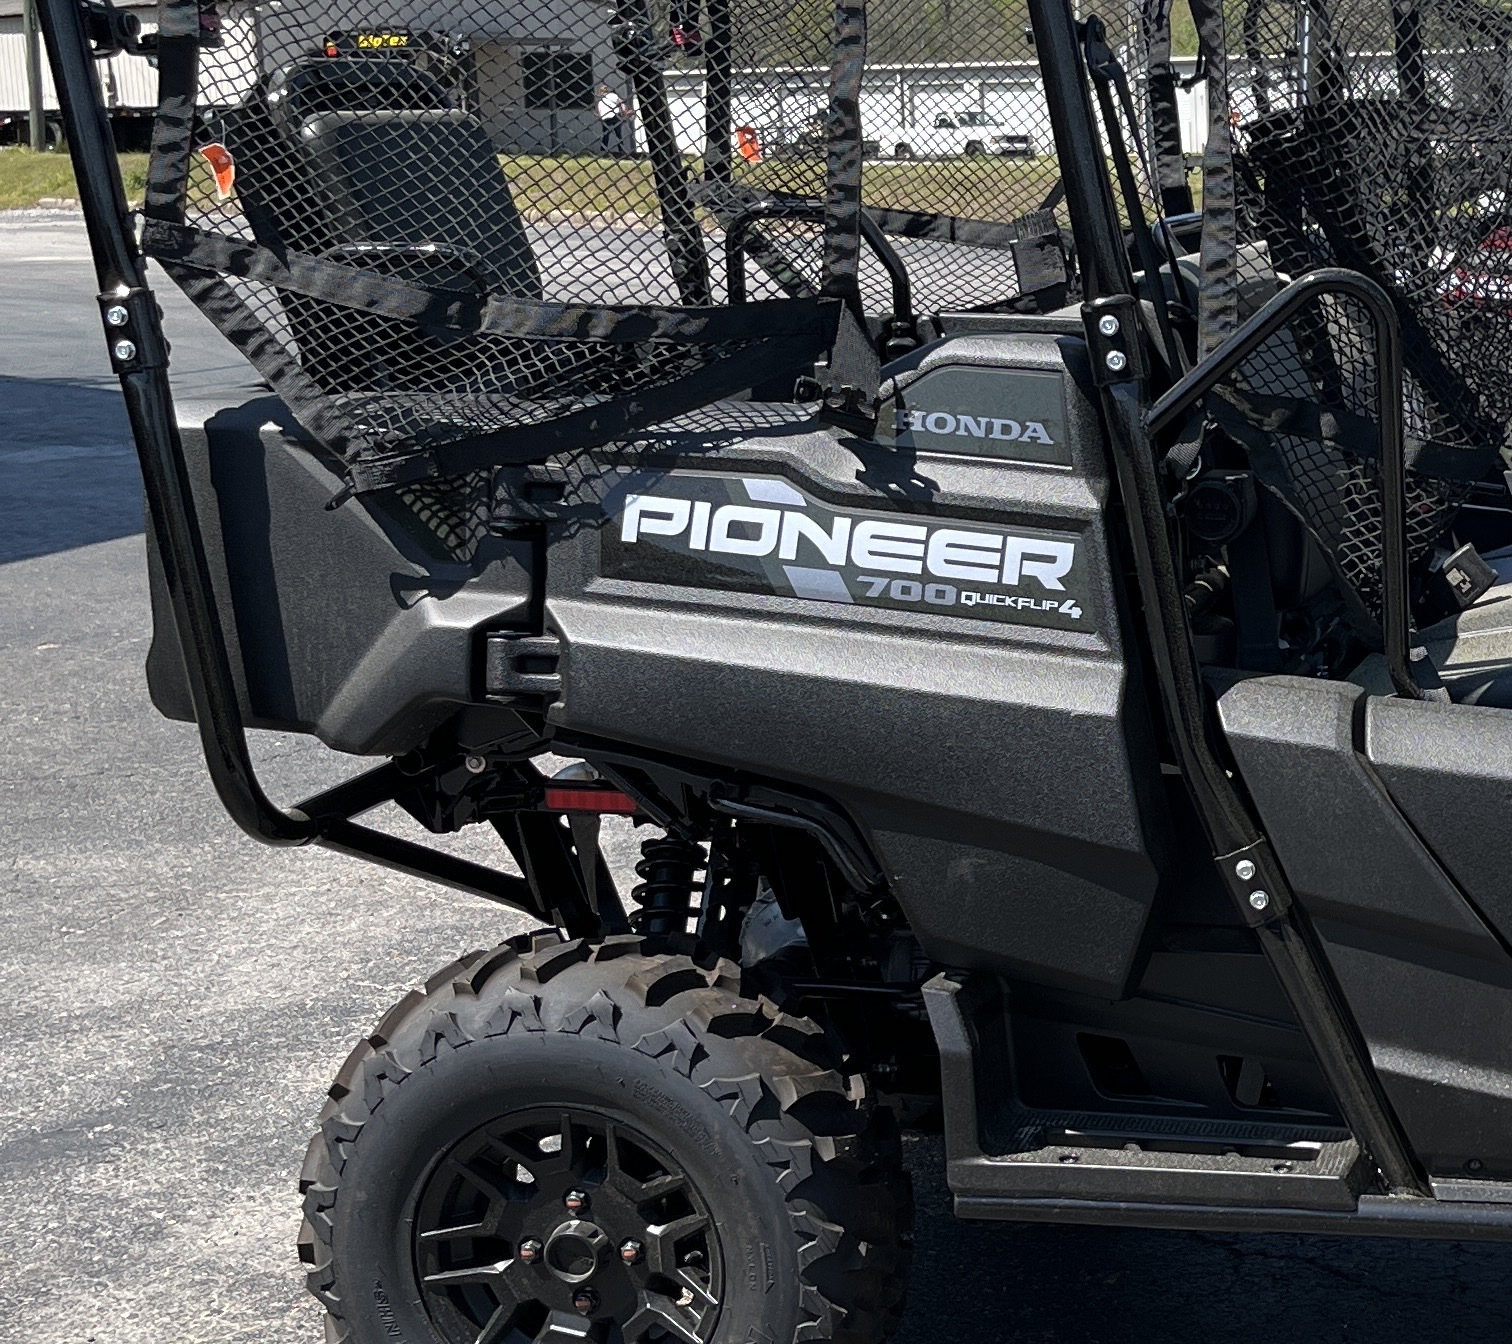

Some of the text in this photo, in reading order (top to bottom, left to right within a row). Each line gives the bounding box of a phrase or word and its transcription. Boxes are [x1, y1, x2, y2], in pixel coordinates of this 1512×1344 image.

[893, 408, 1054, 446] HONDA
[620, 493, 1075, 591] PIONEER
[856, 576, 957, 606] 700
